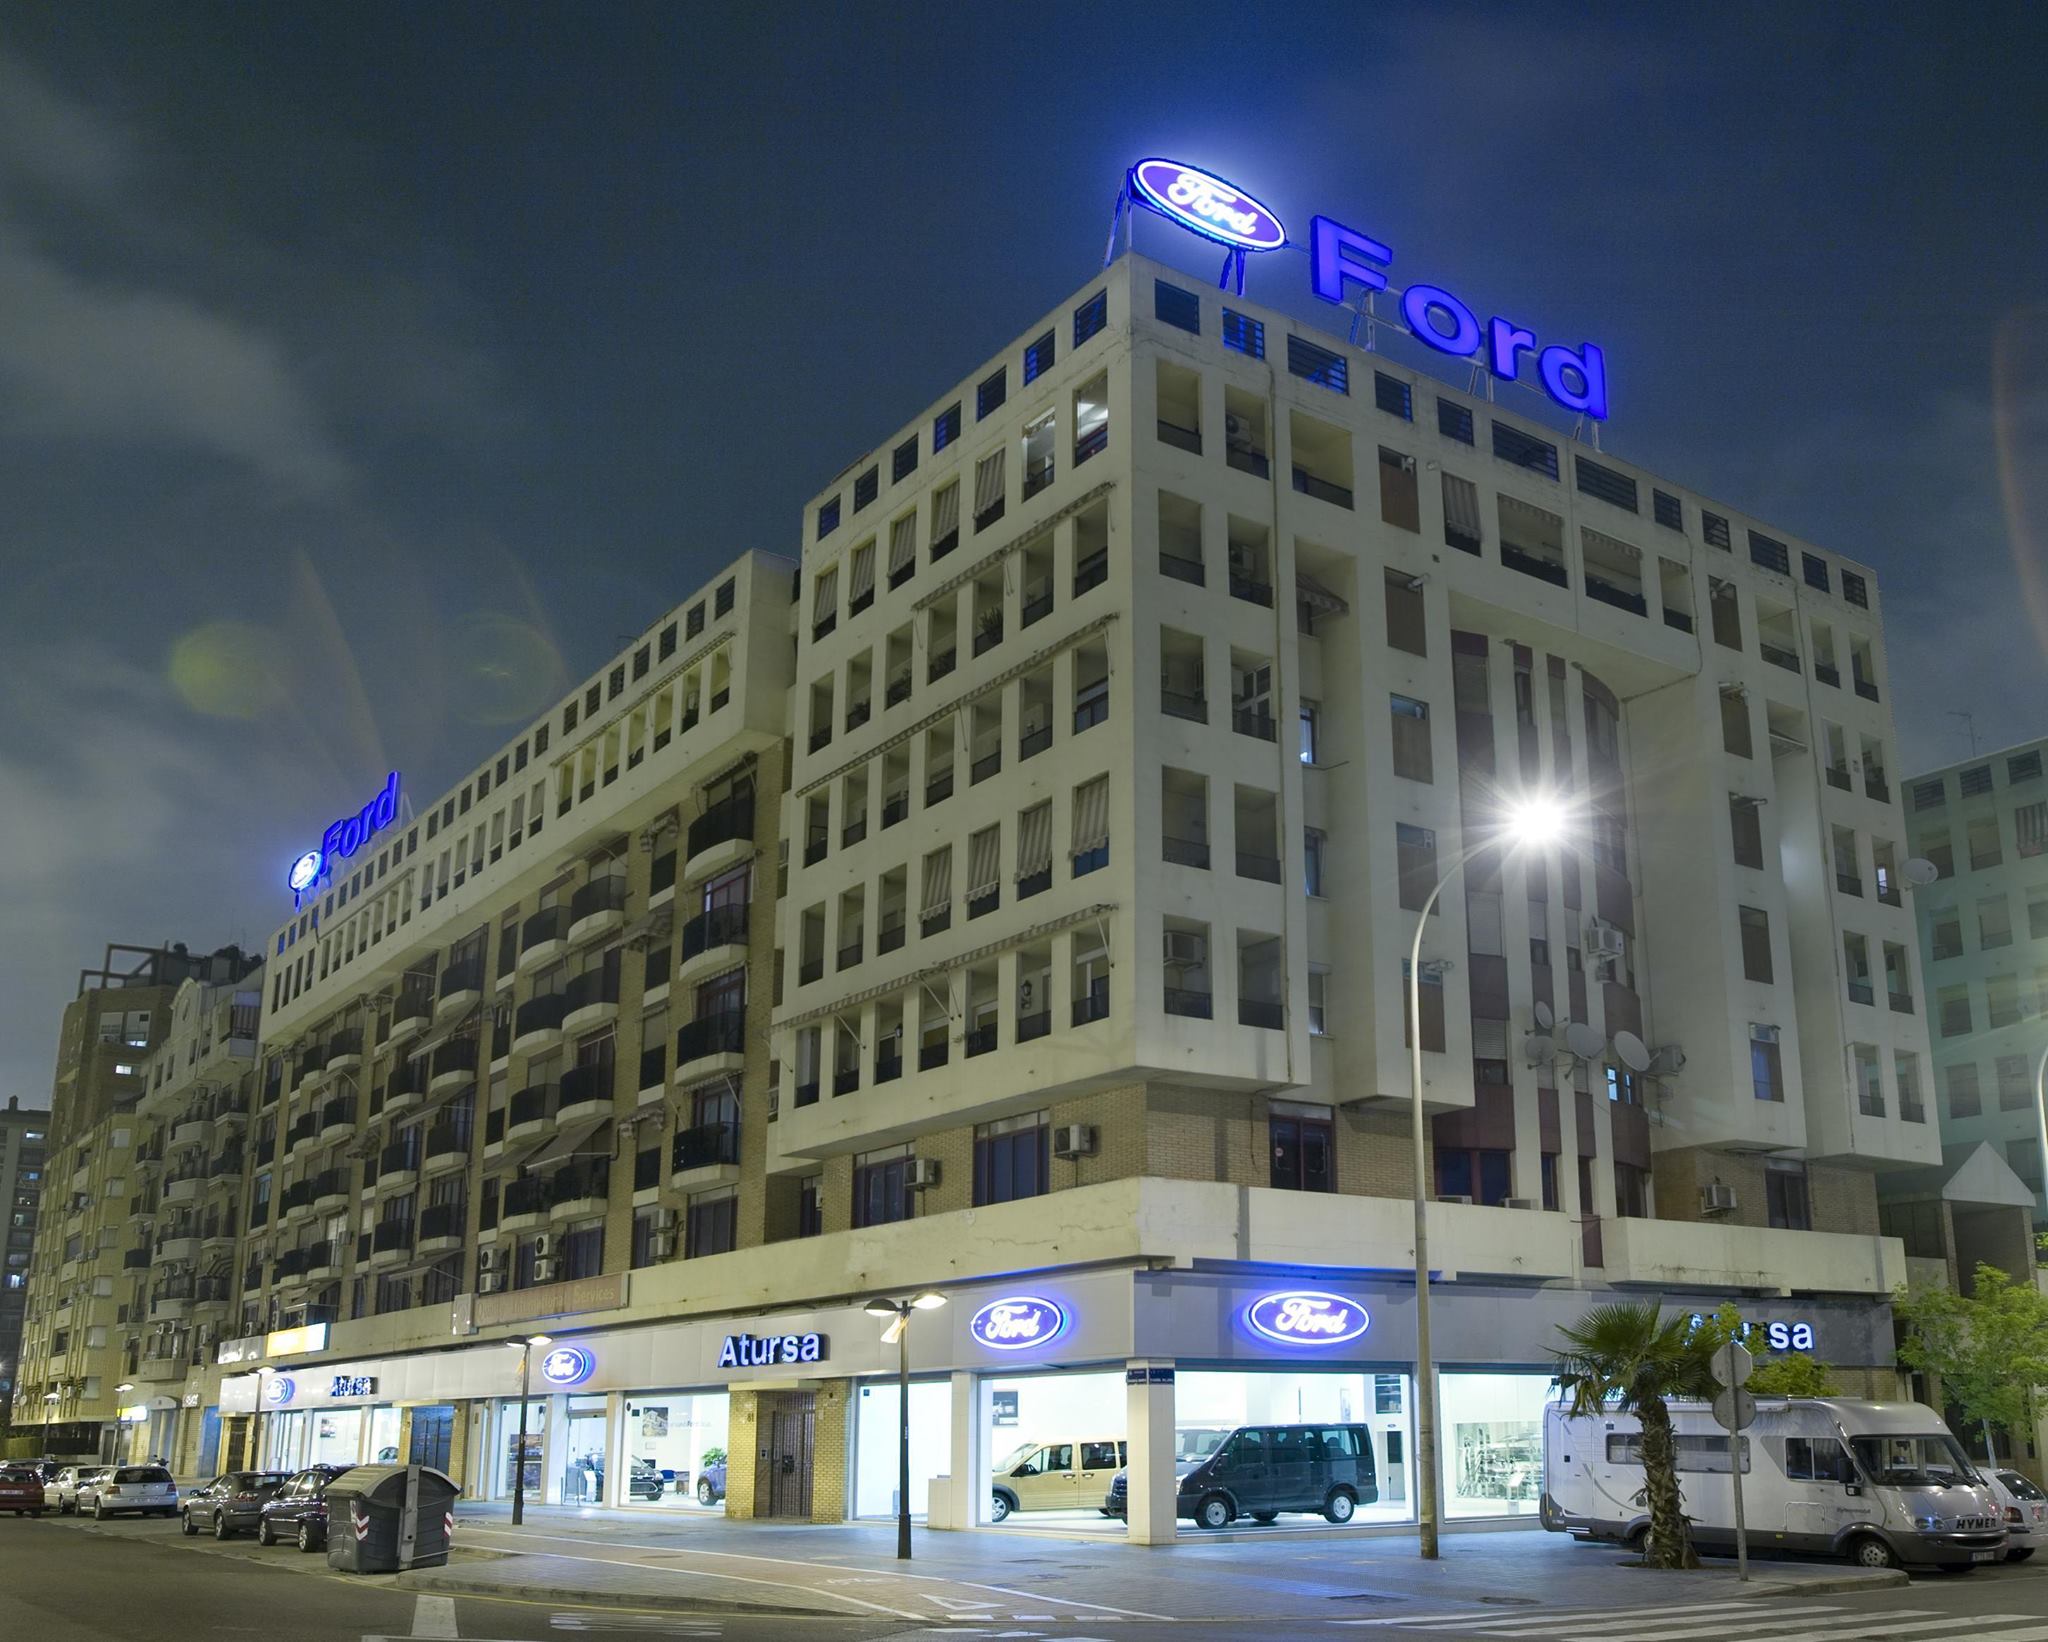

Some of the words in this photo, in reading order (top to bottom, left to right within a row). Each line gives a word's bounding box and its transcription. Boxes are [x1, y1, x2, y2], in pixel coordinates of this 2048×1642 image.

[1168, 172, 1257, 235] Ford
[1310, 214, 1608, 422] Ford
[319, 770, 399, 877] Ford
[985, 1304, 1041, 1339] Ford
[1275, 1298, 1349, 1333] Ford
[1683, 1313, 1815, 1350] Ausa
[718, 1332, 821, 1367] Atursa
[1956, 1517, 1997, 1530] HYMER
